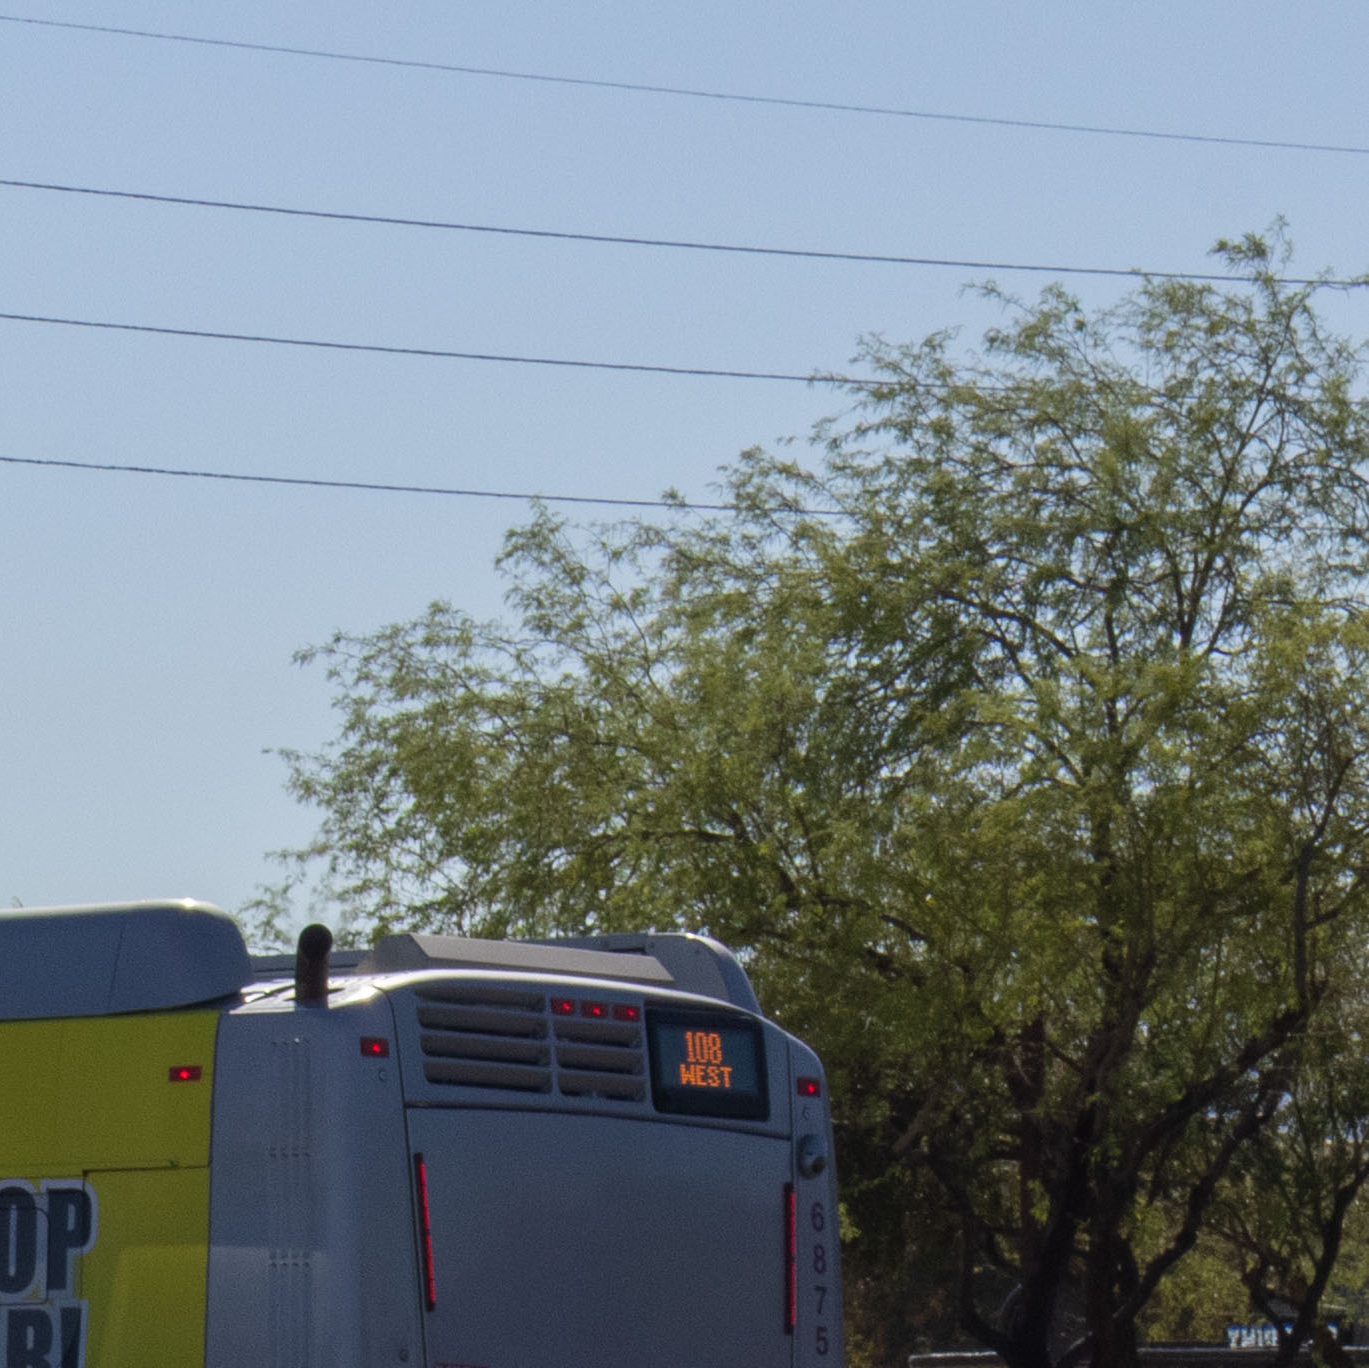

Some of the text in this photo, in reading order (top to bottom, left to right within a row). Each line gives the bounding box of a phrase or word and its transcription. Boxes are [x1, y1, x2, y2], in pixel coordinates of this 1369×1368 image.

[685, 1031, 722, 1064] 108
[679, 1064, 733, 1089] WEST
[810, 1202, 829, 1356] 6875
